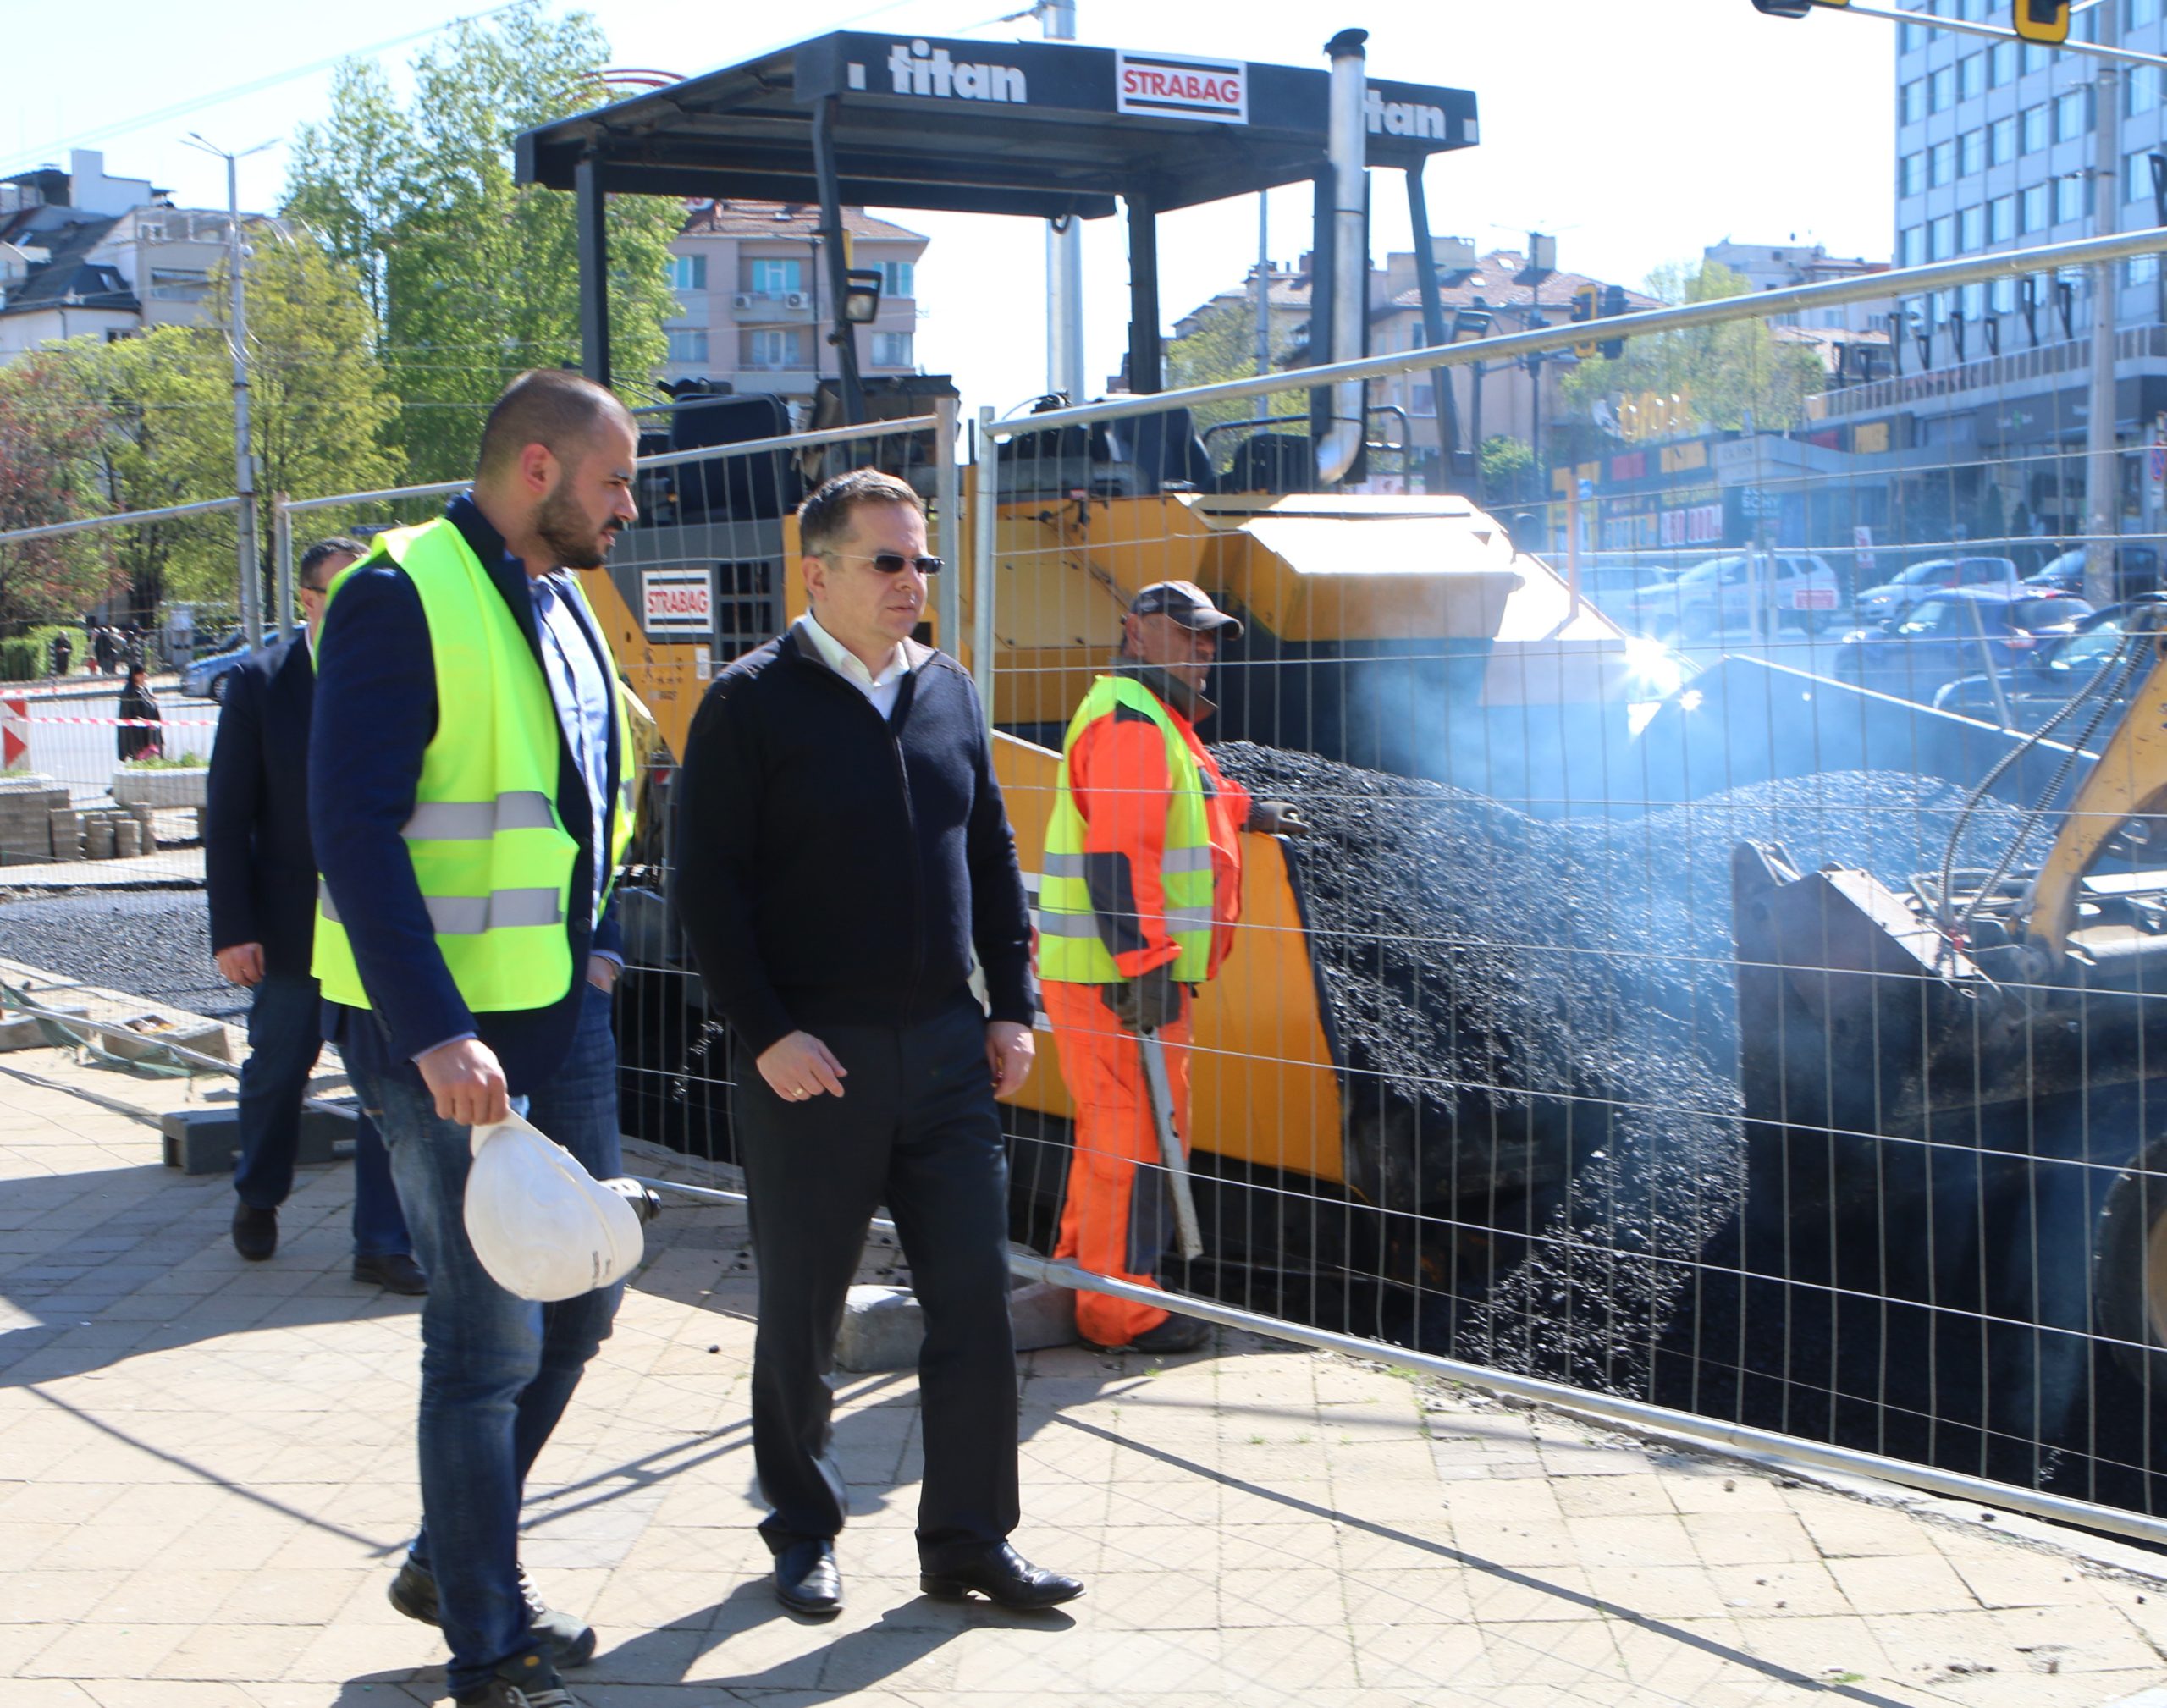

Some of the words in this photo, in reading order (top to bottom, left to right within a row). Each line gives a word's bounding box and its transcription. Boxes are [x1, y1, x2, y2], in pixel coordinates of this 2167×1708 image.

[888, 39, 1027, 103] titan
[1123, 69, 1241, 103] STRABAG
[1364, 89, 1446, 140] tan
[648, 590, 708, 614] STRABAG
